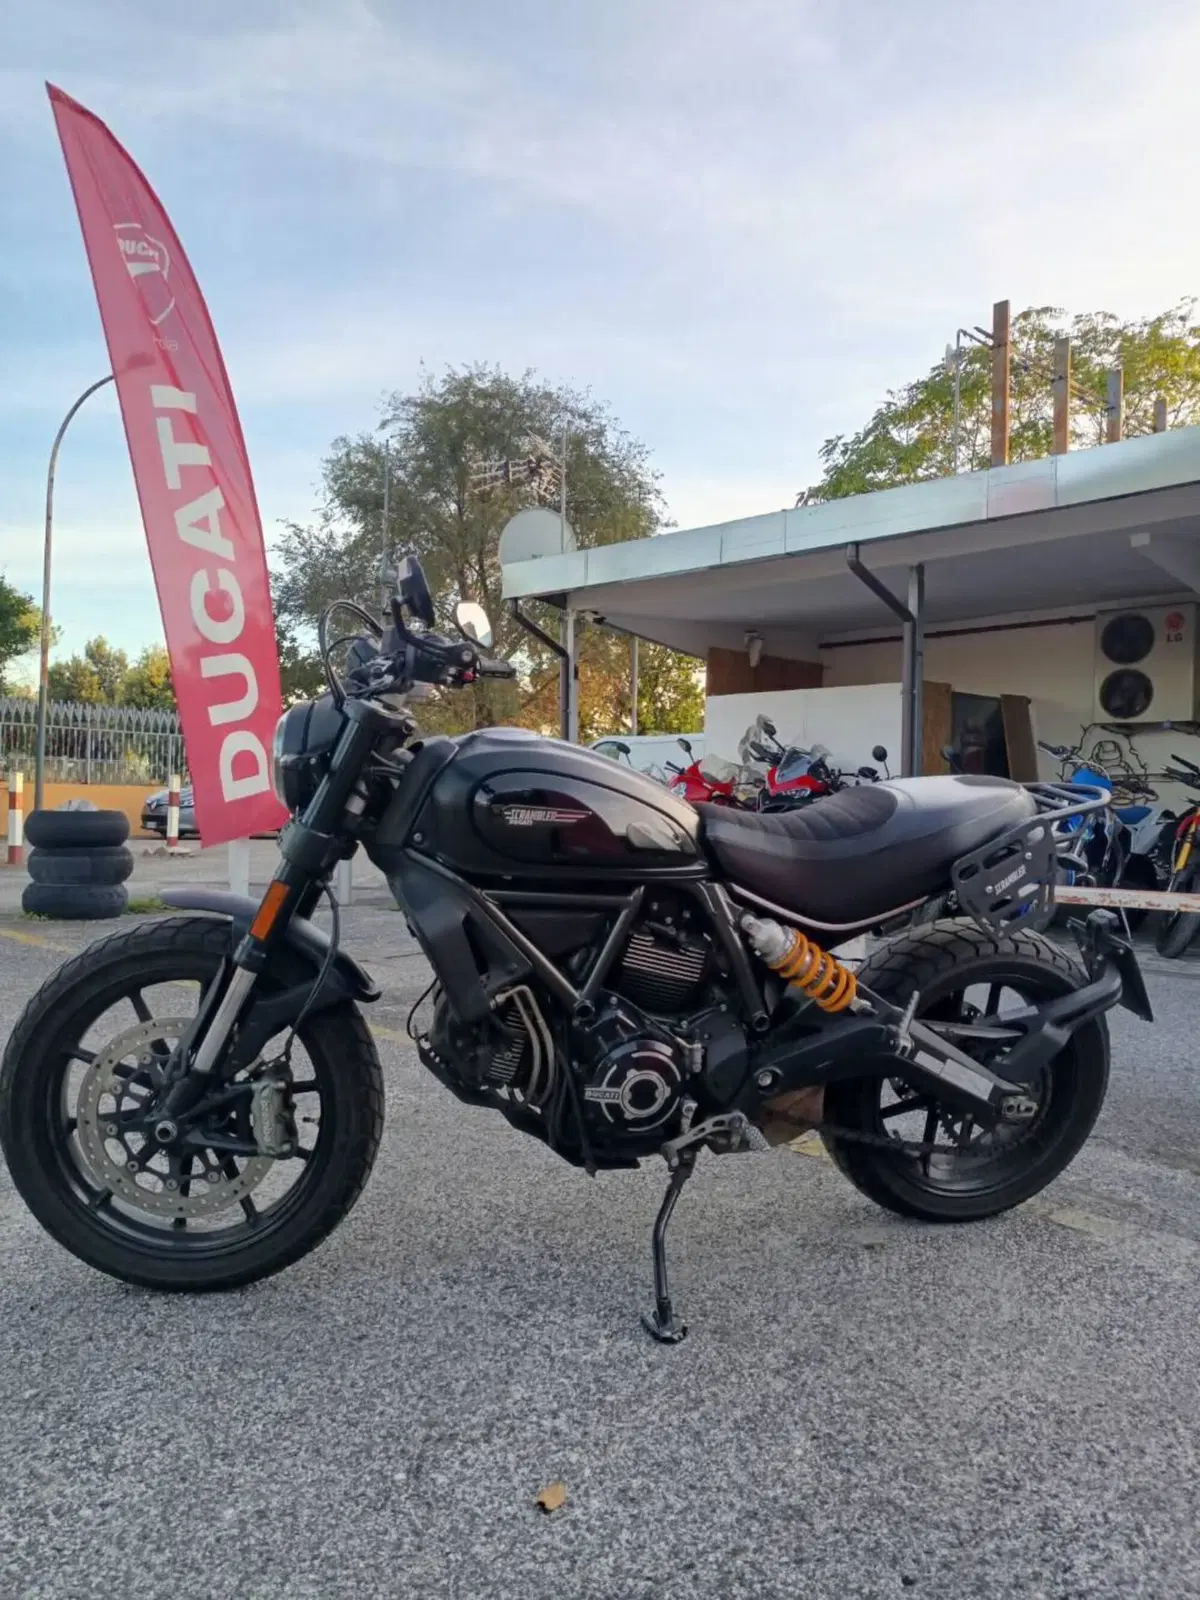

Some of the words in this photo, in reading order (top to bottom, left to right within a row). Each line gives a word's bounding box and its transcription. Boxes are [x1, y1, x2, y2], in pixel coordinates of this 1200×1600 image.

[150, 384, 270, 802] DUCATI
[1167, 633, 1183, 643] LG
[994, 864, 1027, 896] SCRAMBLER
[585, 1090, 620, 1101] DUCATI
